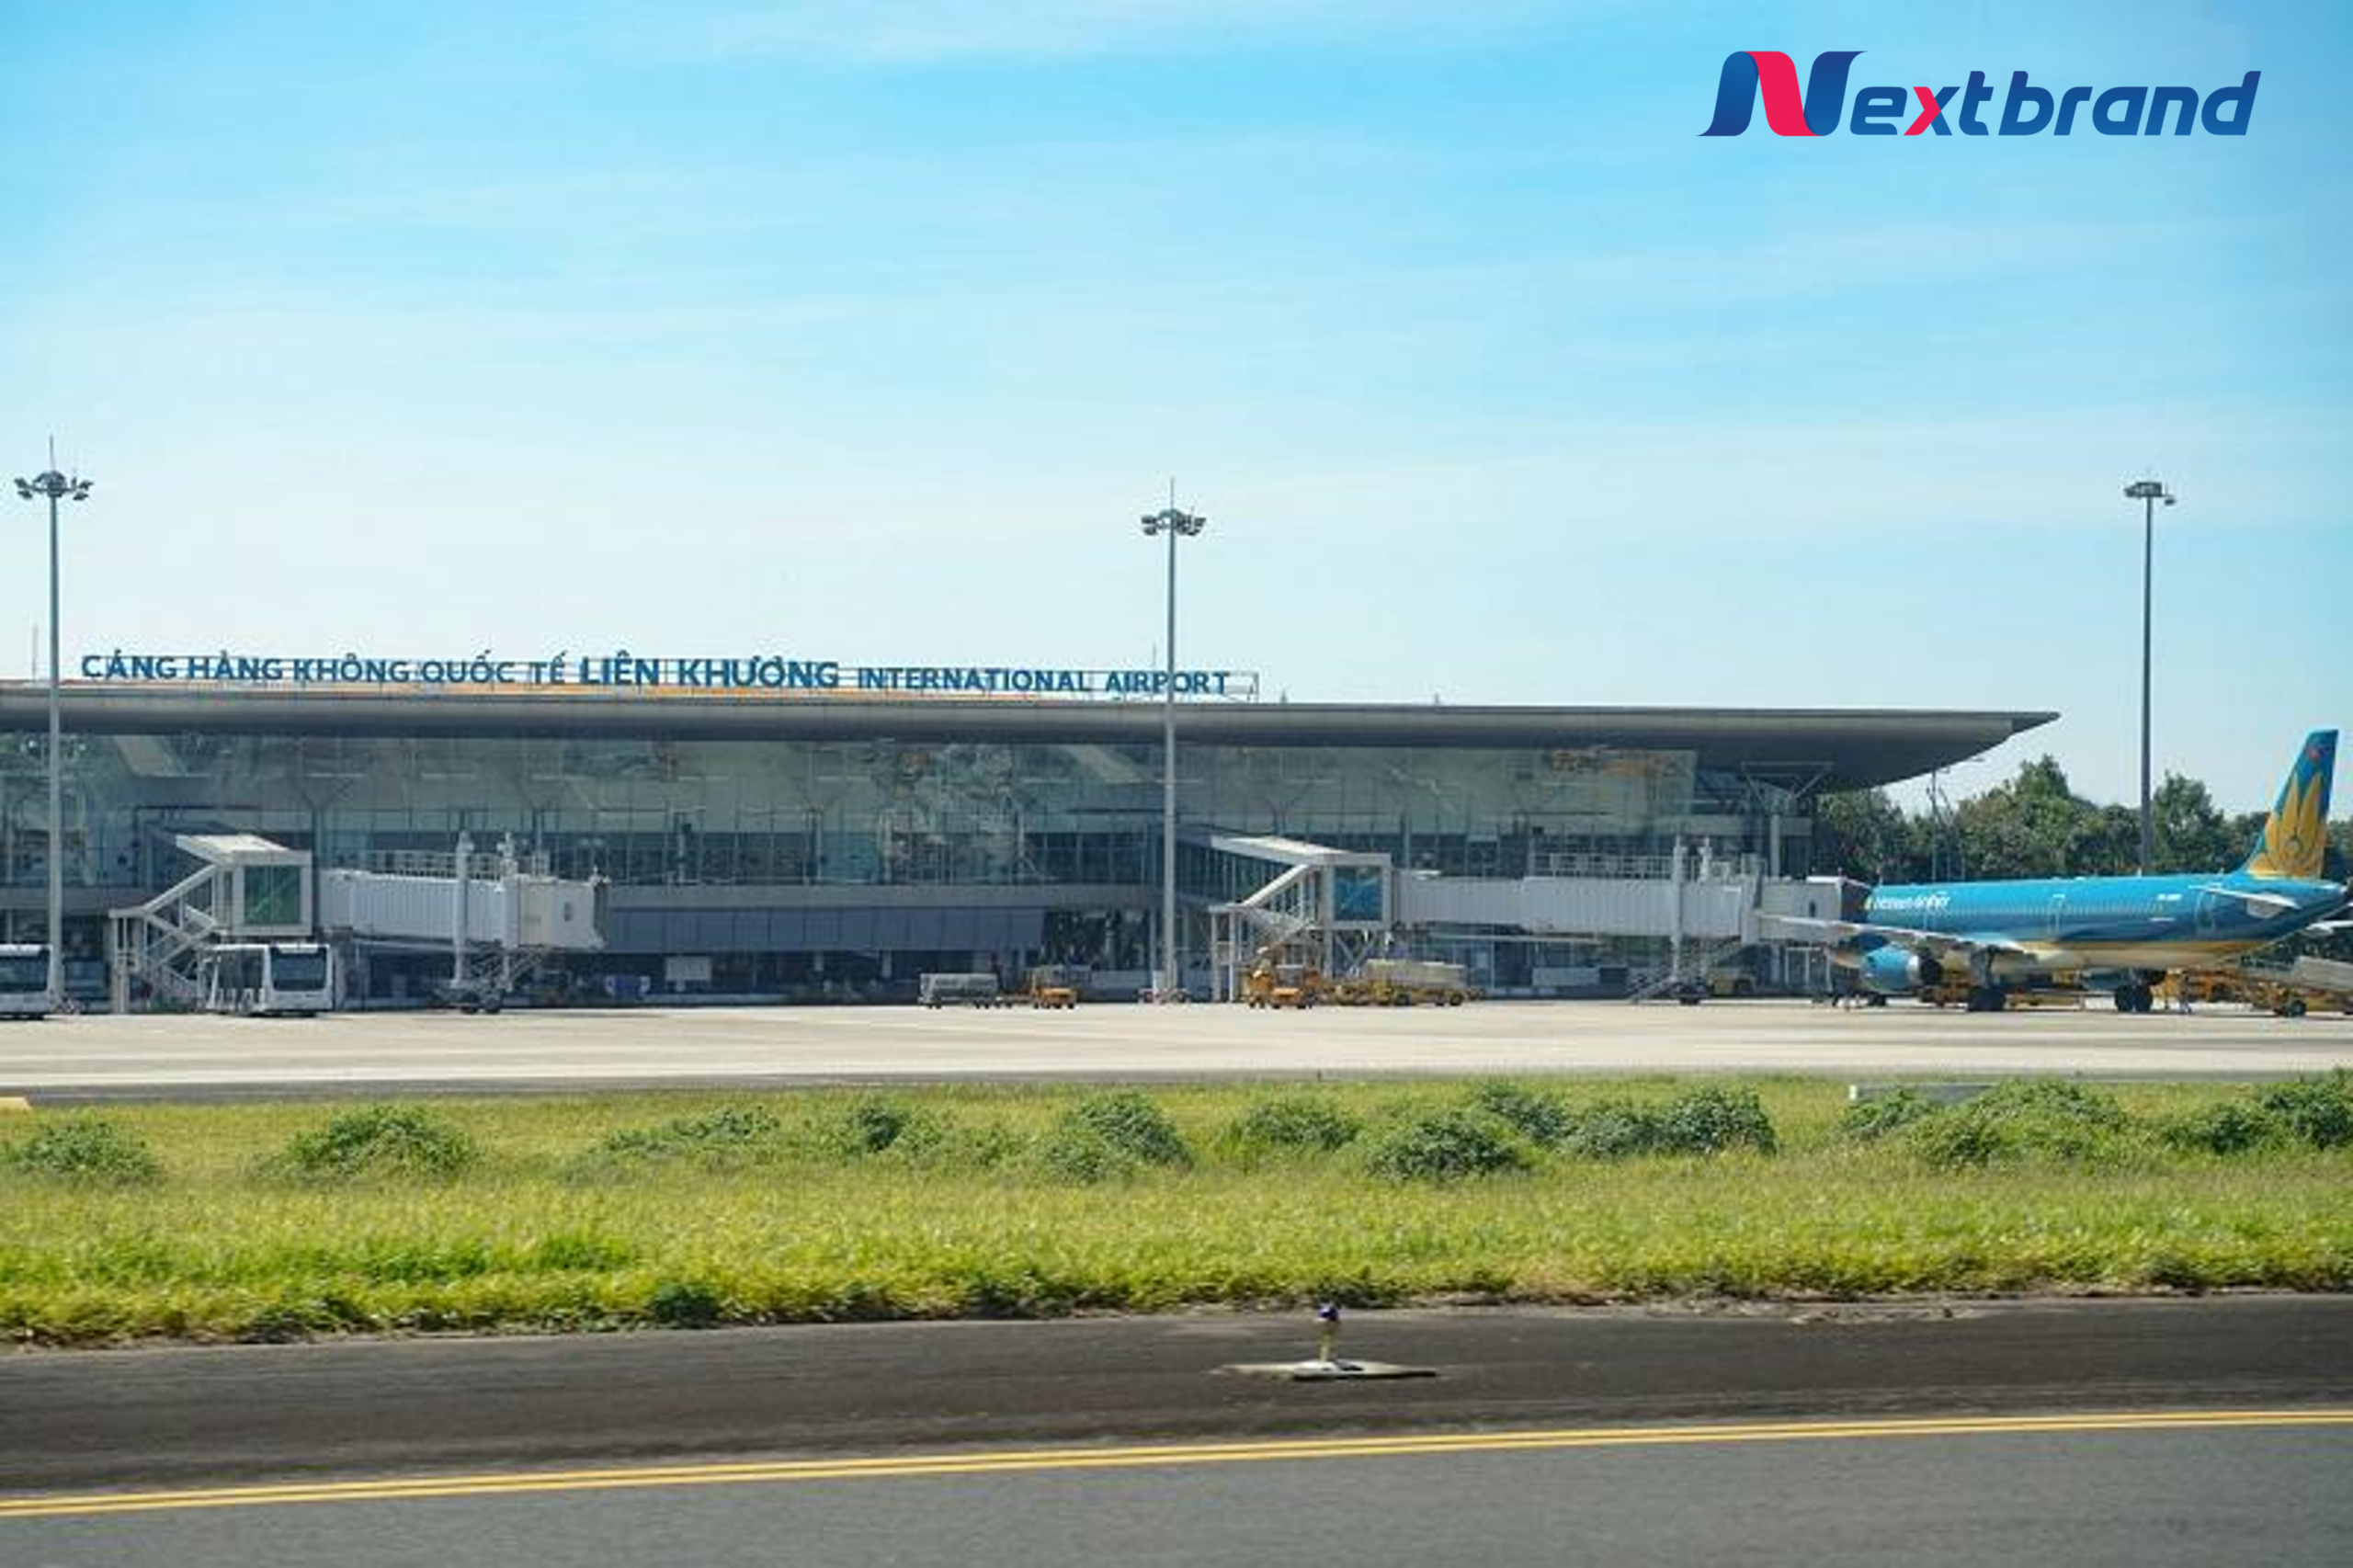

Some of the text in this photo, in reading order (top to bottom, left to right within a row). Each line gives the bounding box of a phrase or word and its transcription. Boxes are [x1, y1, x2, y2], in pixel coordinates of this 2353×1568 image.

[82, 648, 177, 679] CẢNG
[292, 653, 411, 683] KHÔNG
[421, 650, 516, 684] QUỐC
[529, 650, 567, 685] TẾ
[580, 651, 659, 686] LIÊN
[678, 655, 839, 687] KHƯƠNG
[858, 667, 1091, 692] INTERNATIONAL
[1106, 671, 1230, 694] AIRPORT
